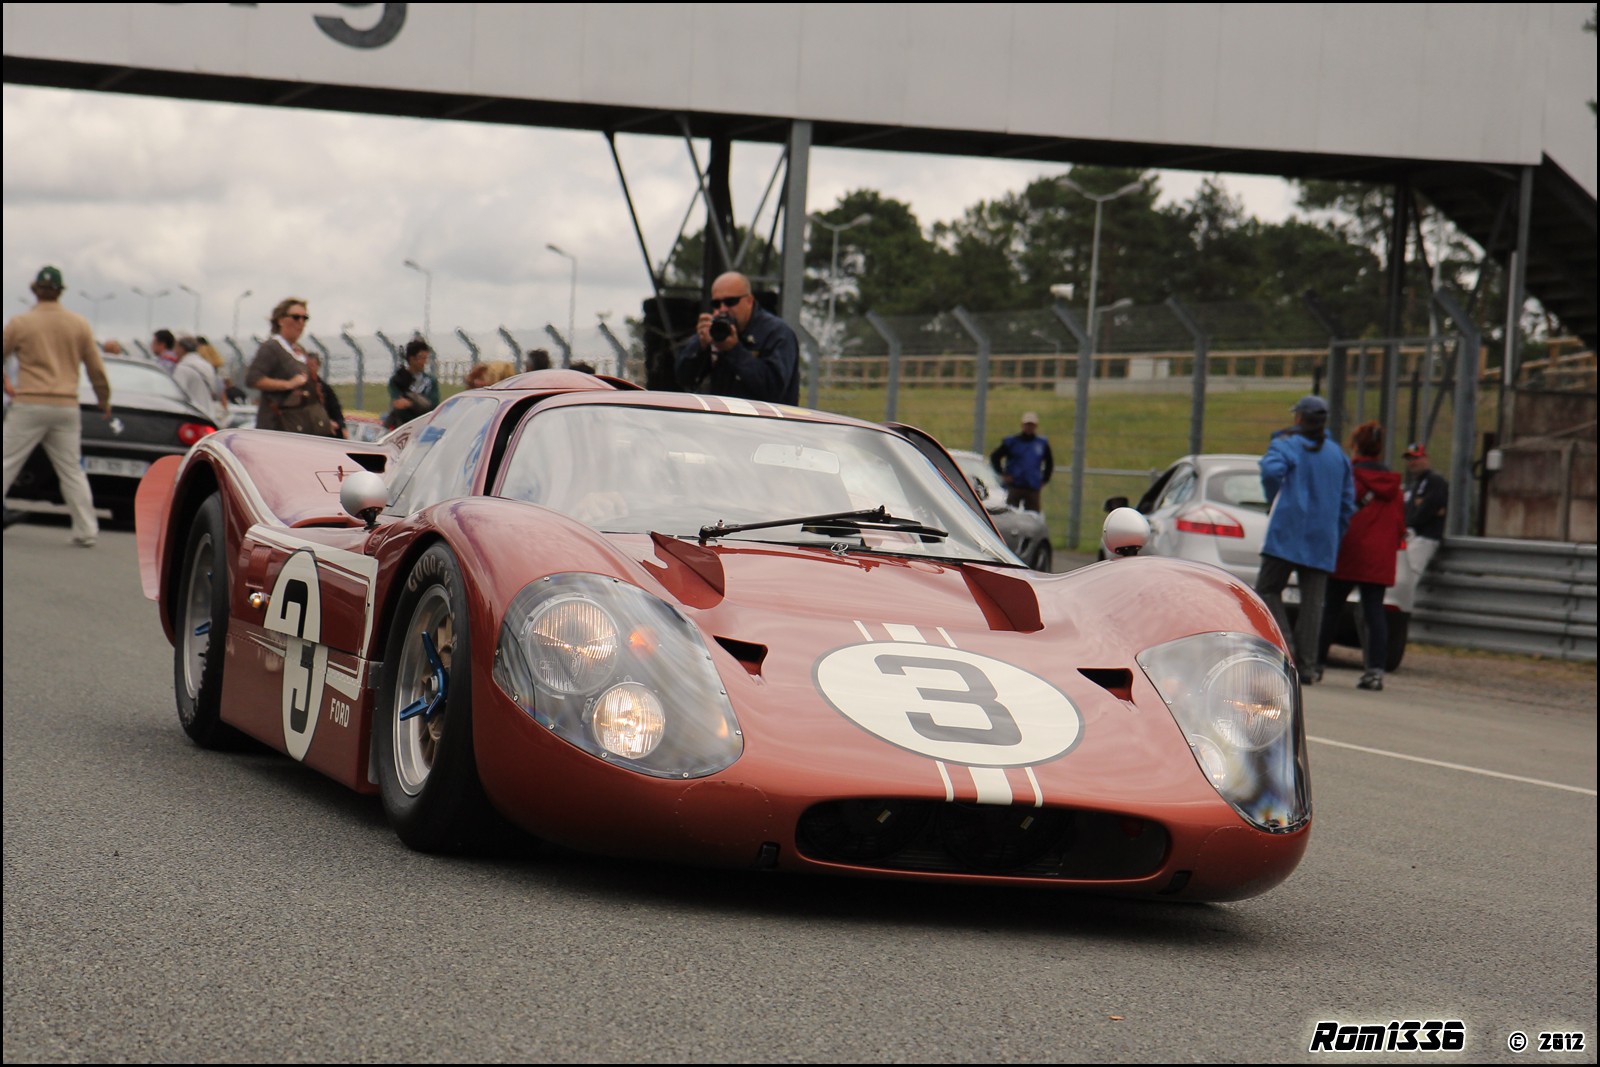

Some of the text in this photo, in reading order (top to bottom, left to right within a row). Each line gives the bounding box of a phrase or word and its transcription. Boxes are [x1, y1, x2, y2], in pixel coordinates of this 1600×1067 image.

[280, 578, 316, 735] 3
[874, 654, 1023, 747] 3
[329, 698, 350, 728] FORD
